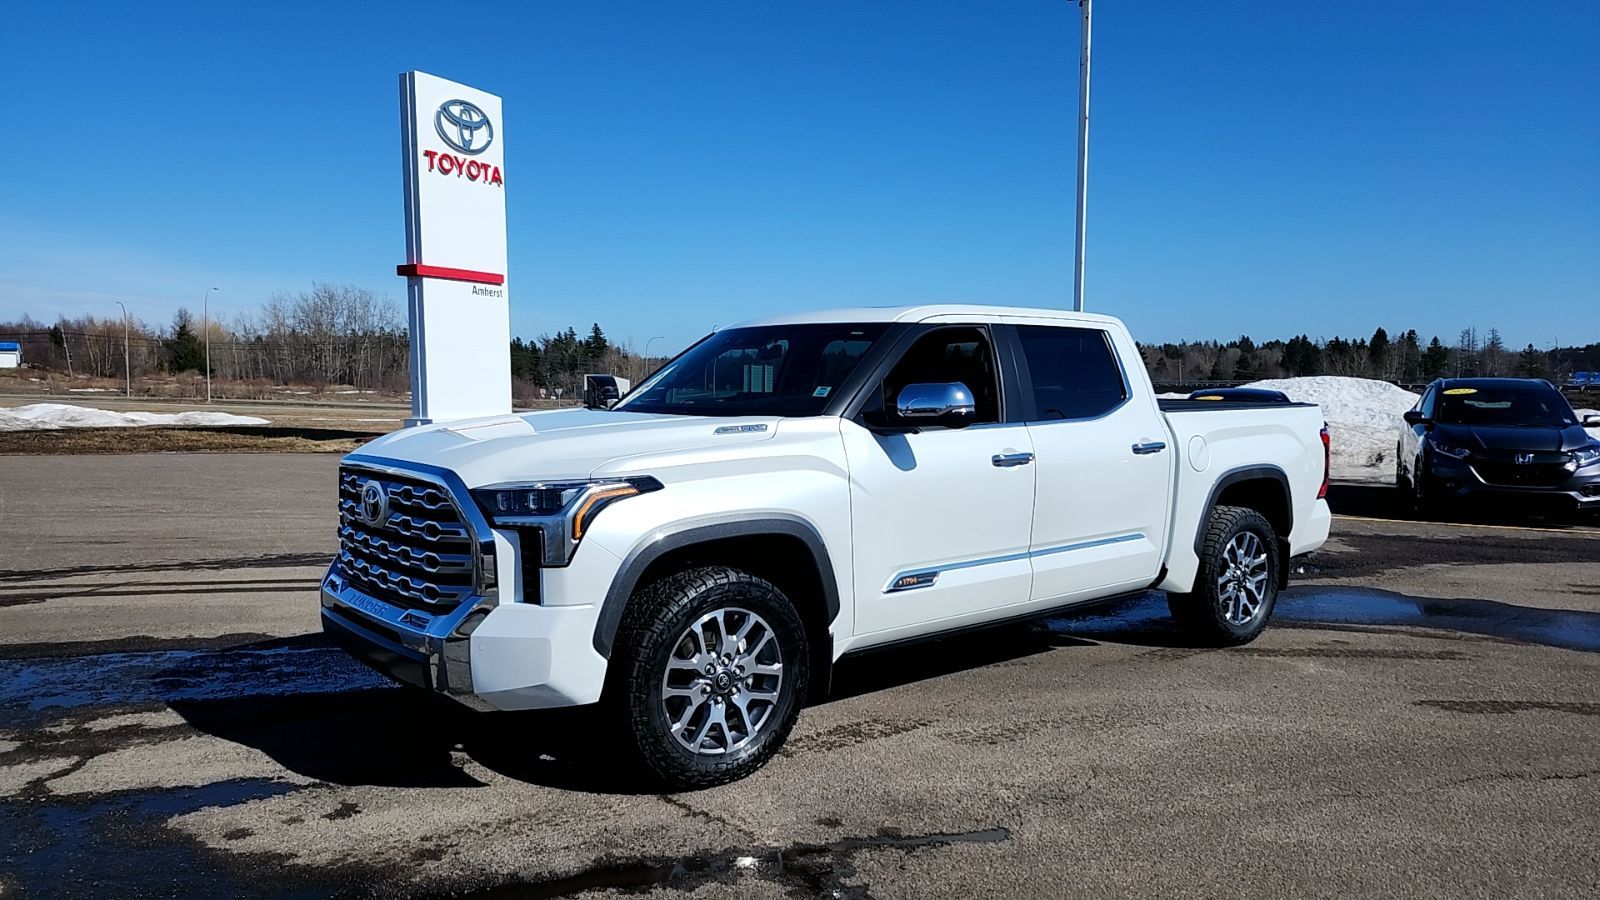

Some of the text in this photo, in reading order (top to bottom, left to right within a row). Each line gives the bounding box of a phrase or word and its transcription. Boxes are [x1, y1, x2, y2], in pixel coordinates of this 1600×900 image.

[423, 150, 503, 186] TOYOTA
[472, 285, 503, 298] Amherst
[903, 576, 917, 584] 1794
